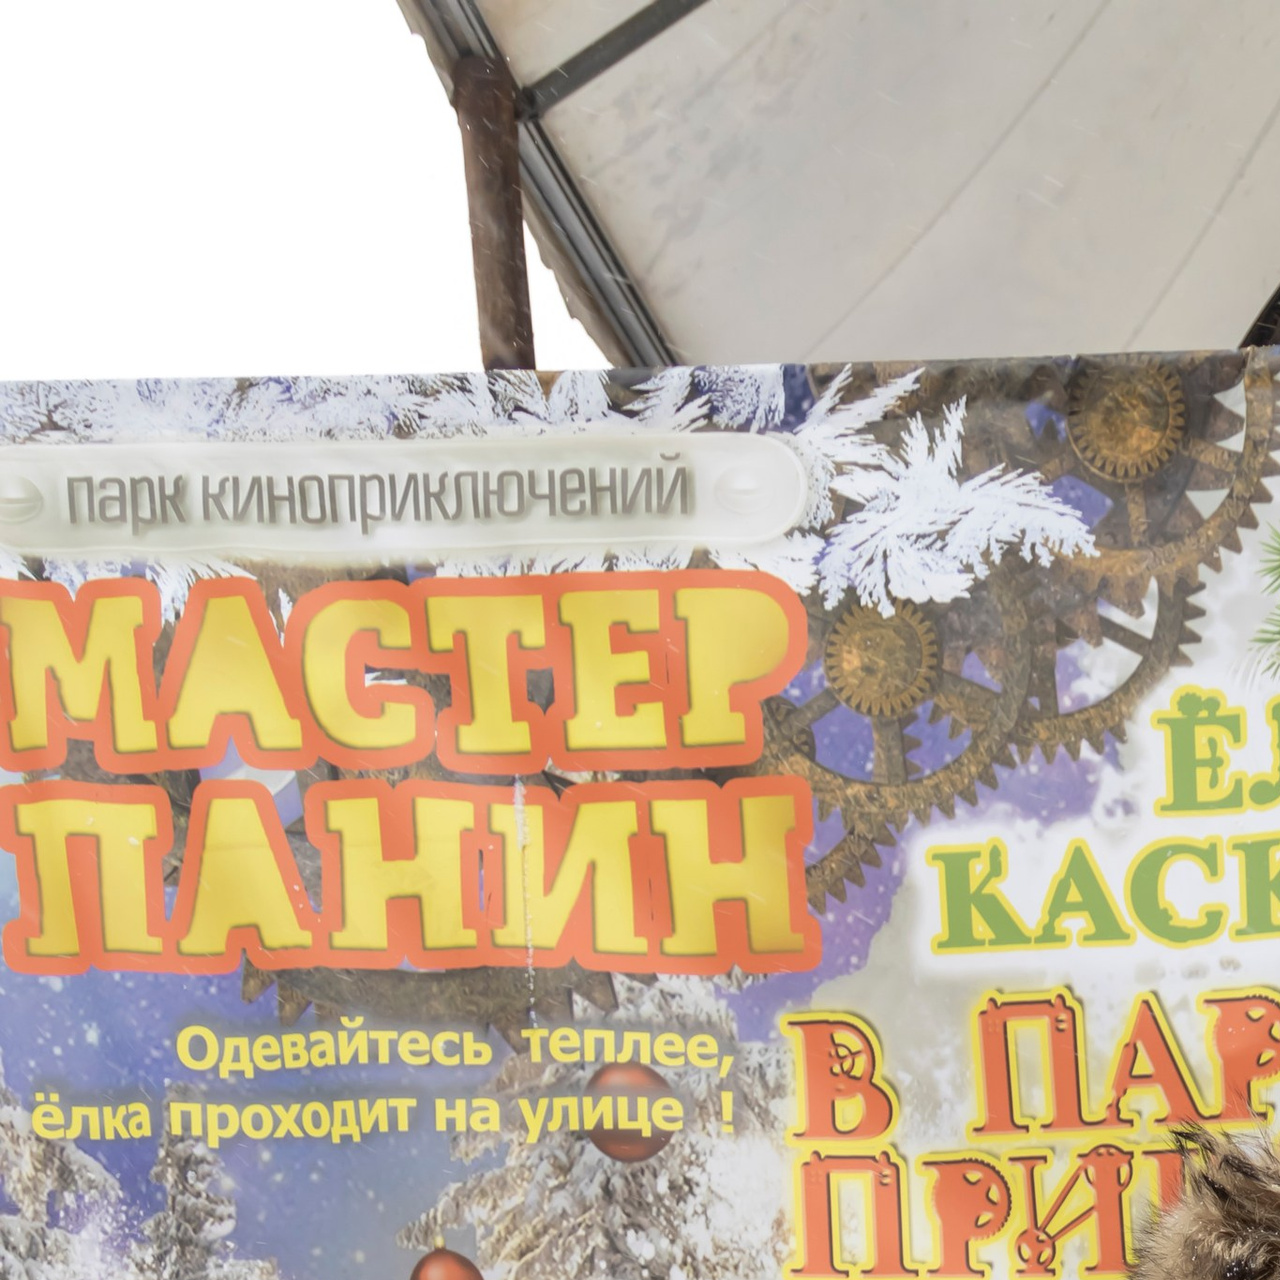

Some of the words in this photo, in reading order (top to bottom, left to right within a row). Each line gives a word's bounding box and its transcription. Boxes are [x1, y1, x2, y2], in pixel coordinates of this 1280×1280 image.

[0, 587, 793, 755] МАСТЕР
[15, 794, 806, 958] ПАНИН
[175, 1016, 494, 1078] Одевайтесь
[521, 1024, 735, 1079] теплее,
[784, 1015, 895, 1140] В
[32, 1092, 152, 1141] ёлка
[169, 1094, 416, 1148] проходит
[435, 1095, 502, 1133] на
[517, 1093, 685, 1145] улице
